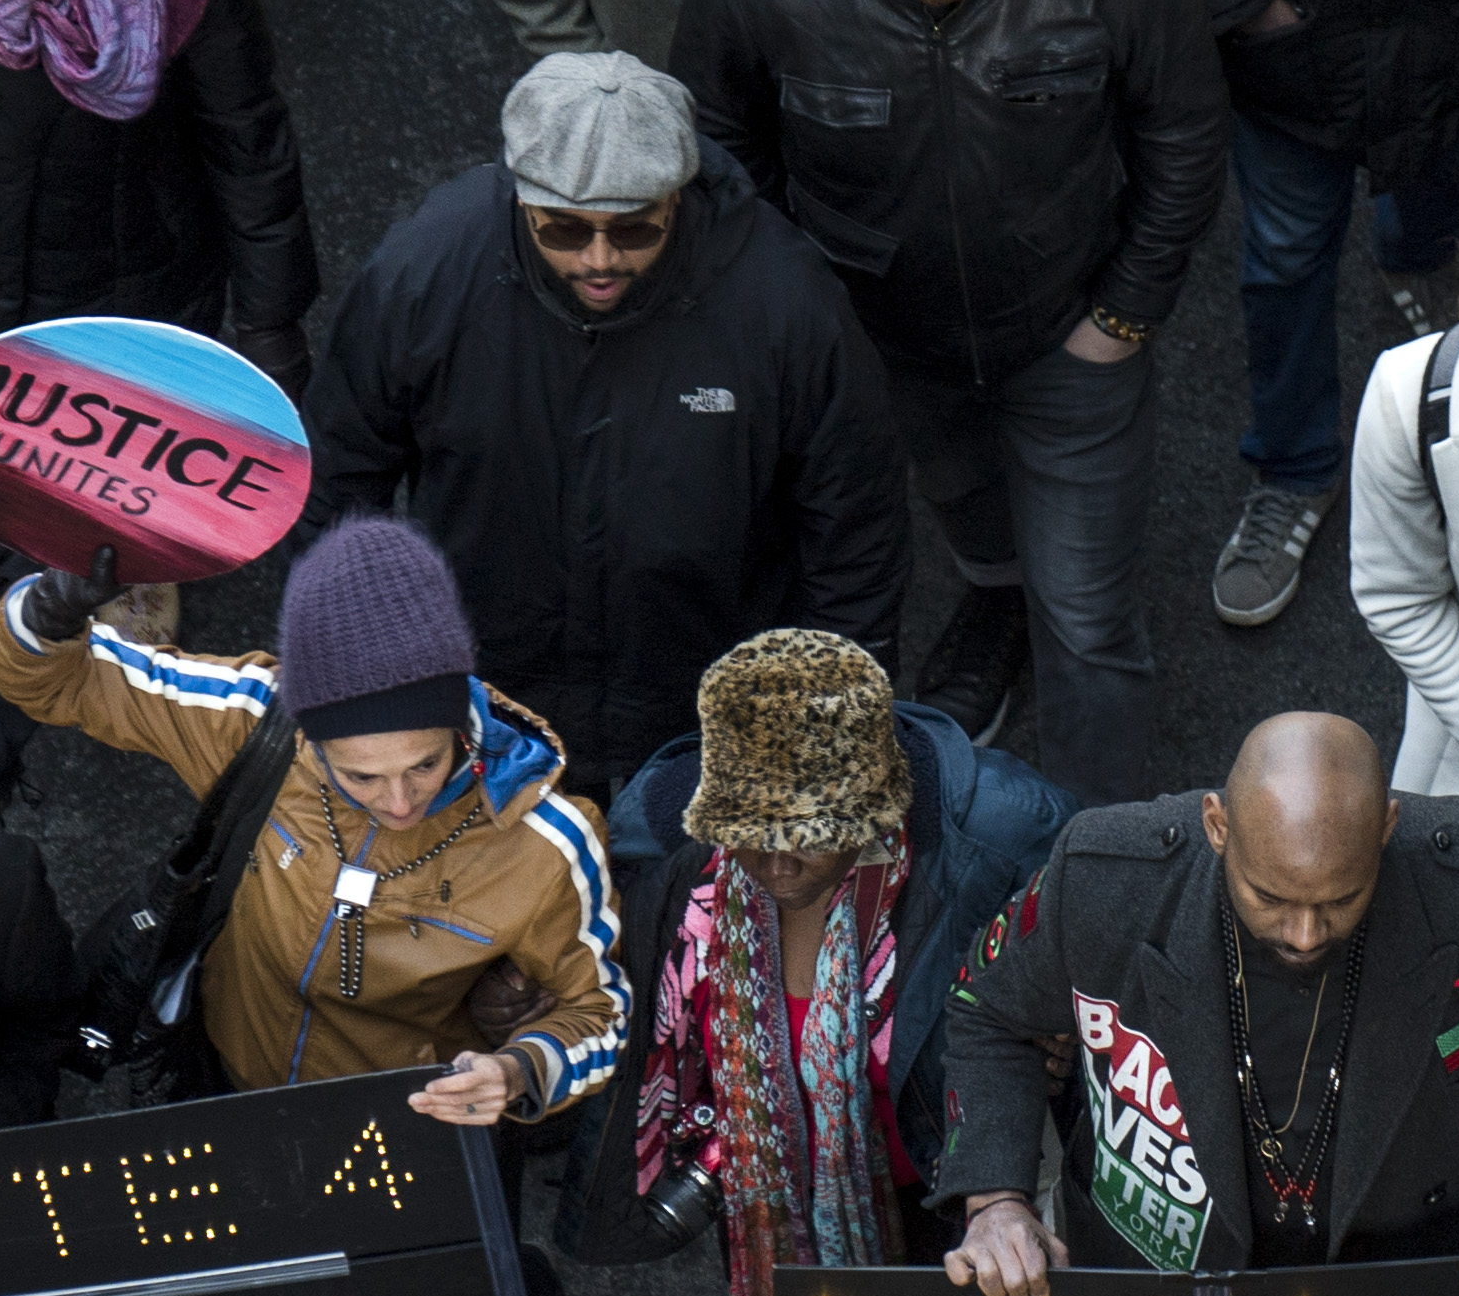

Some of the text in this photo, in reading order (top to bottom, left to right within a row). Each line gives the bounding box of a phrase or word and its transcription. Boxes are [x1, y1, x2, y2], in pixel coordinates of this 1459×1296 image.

[1078, 998, 1189, 1137] BAC
[324, 1118, 414, 1210] 4
[1095, 1140, 1197, 1250] TTER
[1112, 1194, 1186, 1266] YORK
